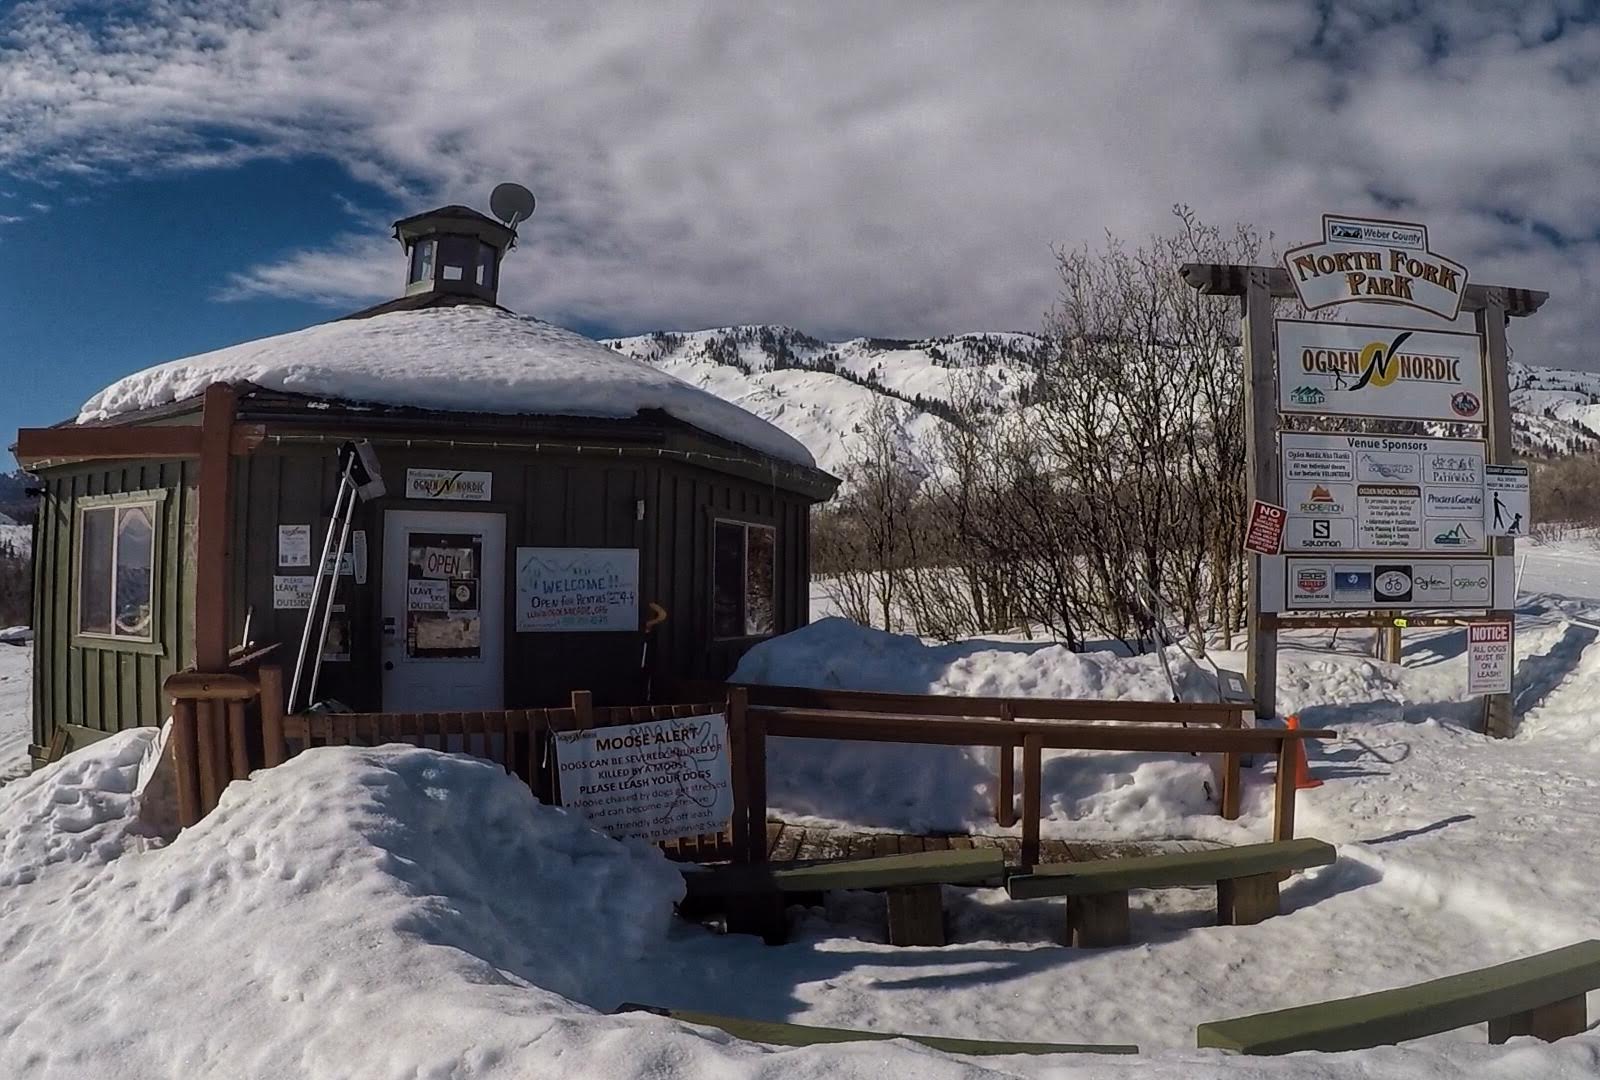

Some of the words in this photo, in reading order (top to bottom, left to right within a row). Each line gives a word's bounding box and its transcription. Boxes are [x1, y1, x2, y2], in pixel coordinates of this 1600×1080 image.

[1363, 228, 1391, 238] Weber
[1391, 230, 1420, 244] County
[1302, 349, 1360, 375] OGDEN
[1400, 355, 1461, 381] NORDIC
[1347, 438, 1380, 449] Venue
[1382, 438, 1428, 451] Sponsors
[1261, 506, 1280, 518] NO
[427, 552, 461, 576] OPEN
[275, 583, 298, 592] LEAVE
[410, 587, 432, 595] LEAVE
[543, 577, 606, 594] WELCOME
[1472, 626, 1508, 641] NOTICE
[1487, 645, 1507, 653] DOGS
[1496, 653, 1504, 661] BE
[596, 734, 650, 752] MOOSE
[655, 727, 699, 745] ALERT
[560, 761, 588, 772] DOGS
[589, 759, 608, 768] CAN
[611, 757, 623, 766] BE
[598, 768, 630, 780] KILLED
[632, 766, 644, 776] BY
[644, 766, 651, 774] A
[653, 760, 688, 773] MOOSE
[580, 783, 616, 795] PLEASE
[618, 779, 649, 791] LEASH
[652, 775, 681, 787] YOUR
[683, 770, 712, 782] DOGS
[574, 799, 602, 809] Moose
[605, 793, 638, 804] chased
[652, 789, 674, 801] dogs
[608, 807, 624, 817] can
[616, 817, 650, 831] friendly
[652, 814, 675, 827] dogs
[676, 812, 688, 822] off
[650, 829, 660, 838] to
